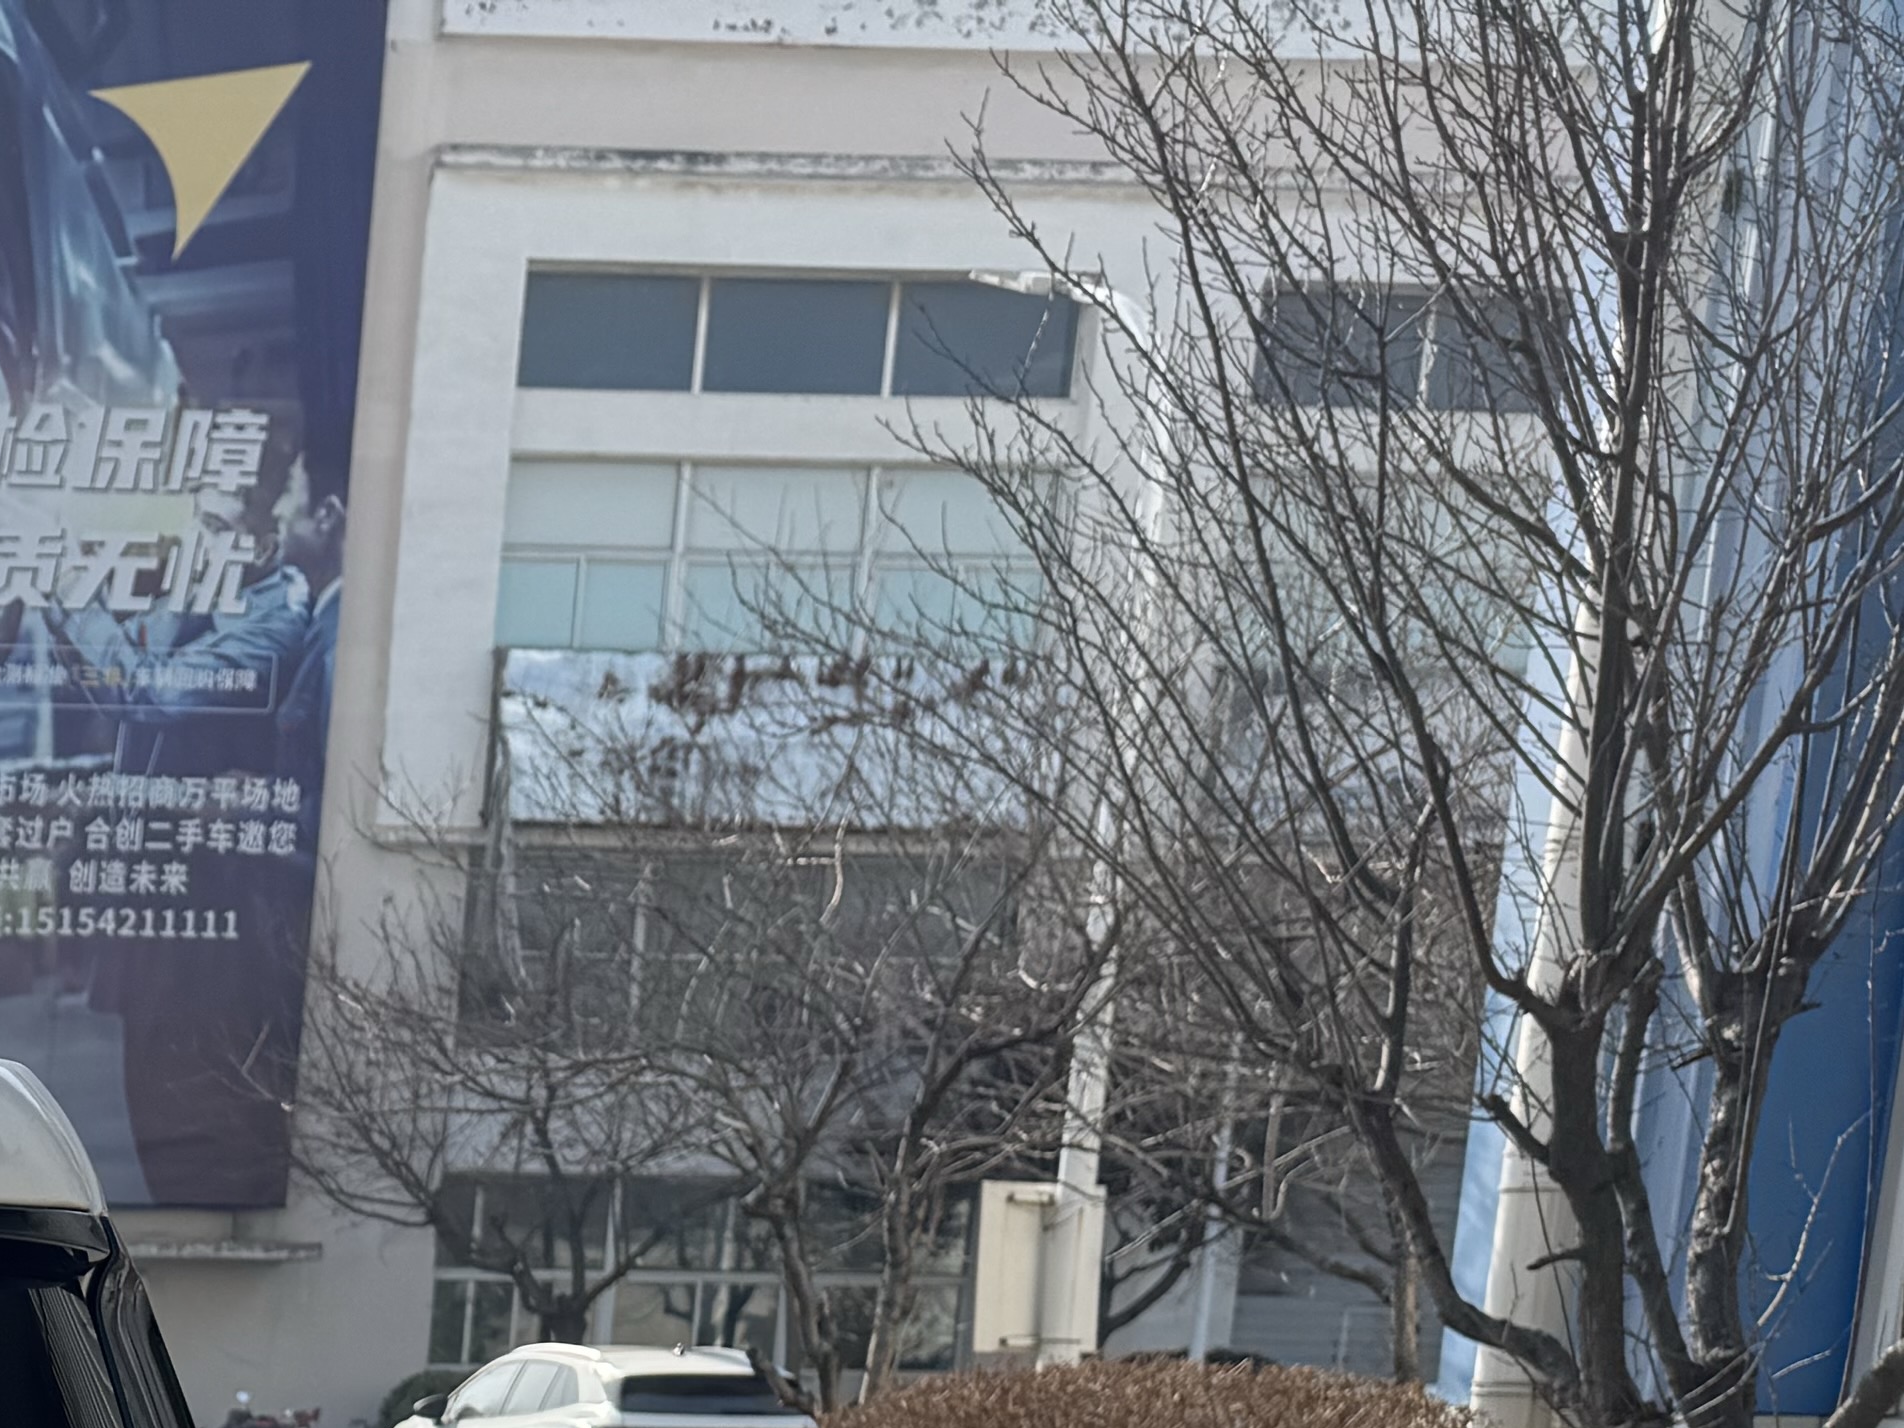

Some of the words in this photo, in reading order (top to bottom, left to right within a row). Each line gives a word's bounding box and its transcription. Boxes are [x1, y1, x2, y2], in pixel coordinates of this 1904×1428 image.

[55, 773, 301, 812] 火热招商万平场地
[84, 818, 298, 856] 合创二手车邀您
[68, 860, 190, 895] 创造未来
